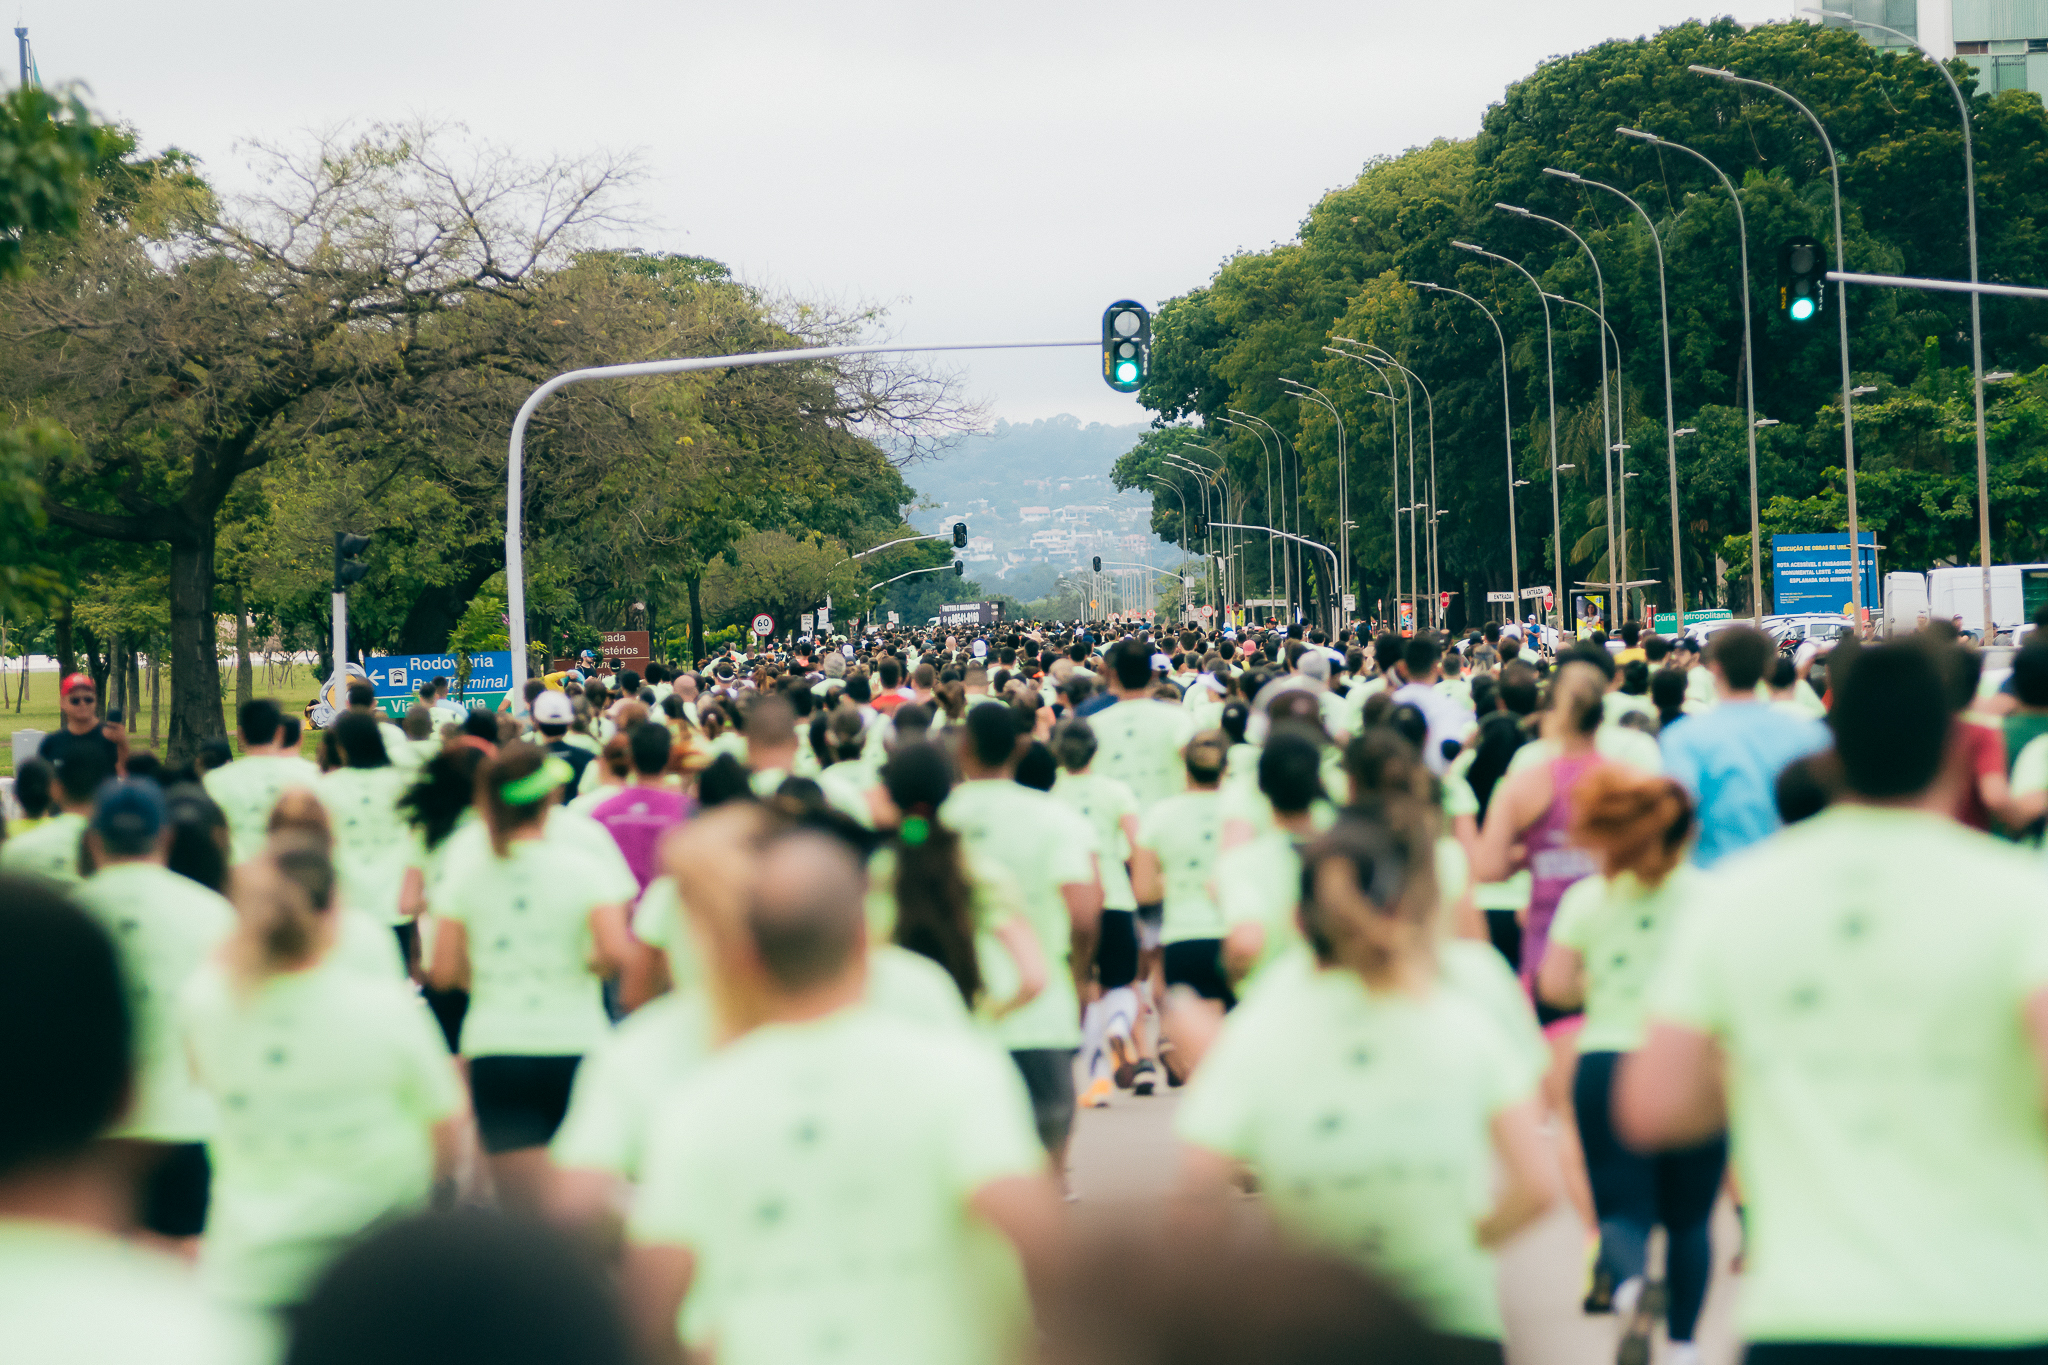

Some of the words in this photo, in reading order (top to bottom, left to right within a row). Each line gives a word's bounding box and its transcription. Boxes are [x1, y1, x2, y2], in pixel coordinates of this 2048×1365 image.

[1655, 613, 1675, 621] Cúria
[1684, 612, 1731, 621] etropolitana
[757, 618, 769, 627] 60
